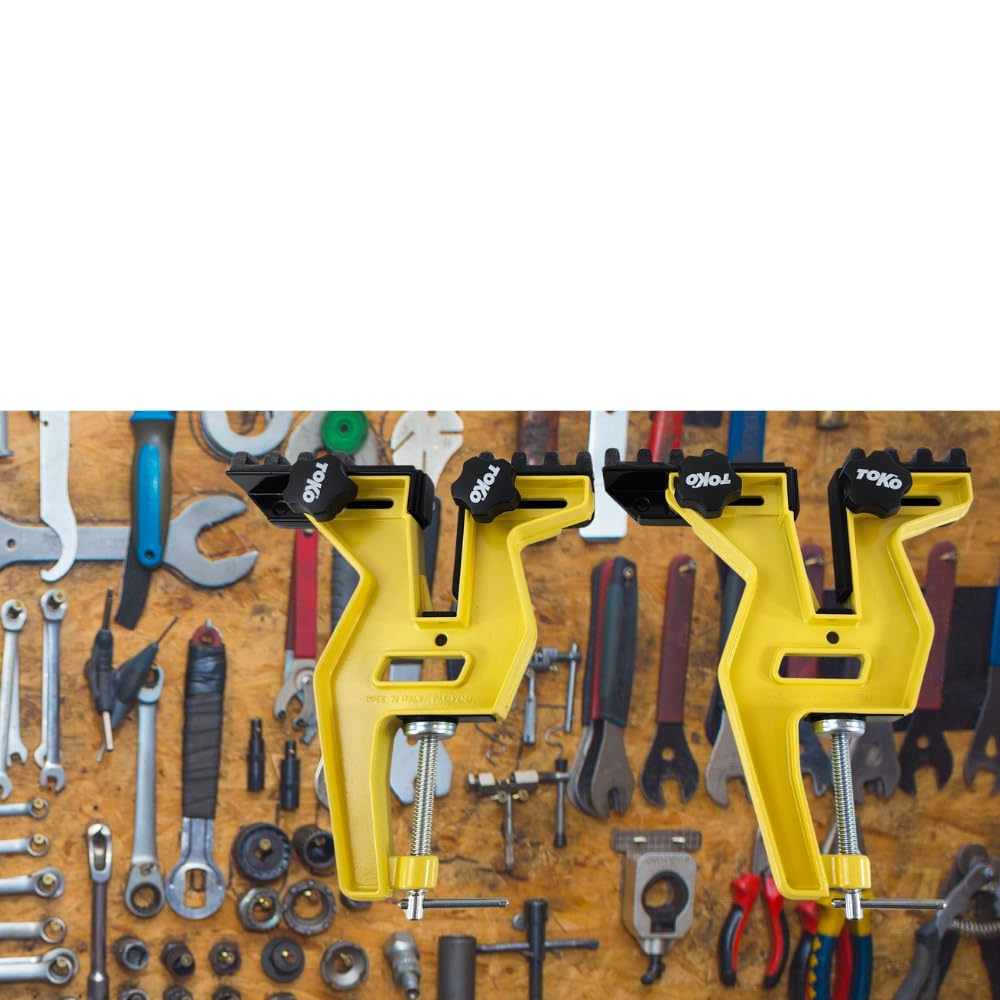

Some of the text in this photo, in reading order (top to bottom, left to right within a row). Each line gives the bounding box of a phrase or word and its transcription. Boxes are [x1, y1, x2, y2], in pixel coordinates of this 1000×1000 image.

[303, 462, 329, 503] TOKO
[470, 464, 501, 503] TOKO
[686, 472, 731, 488] TOKO
[856, 468, 902, 489] TOKO
